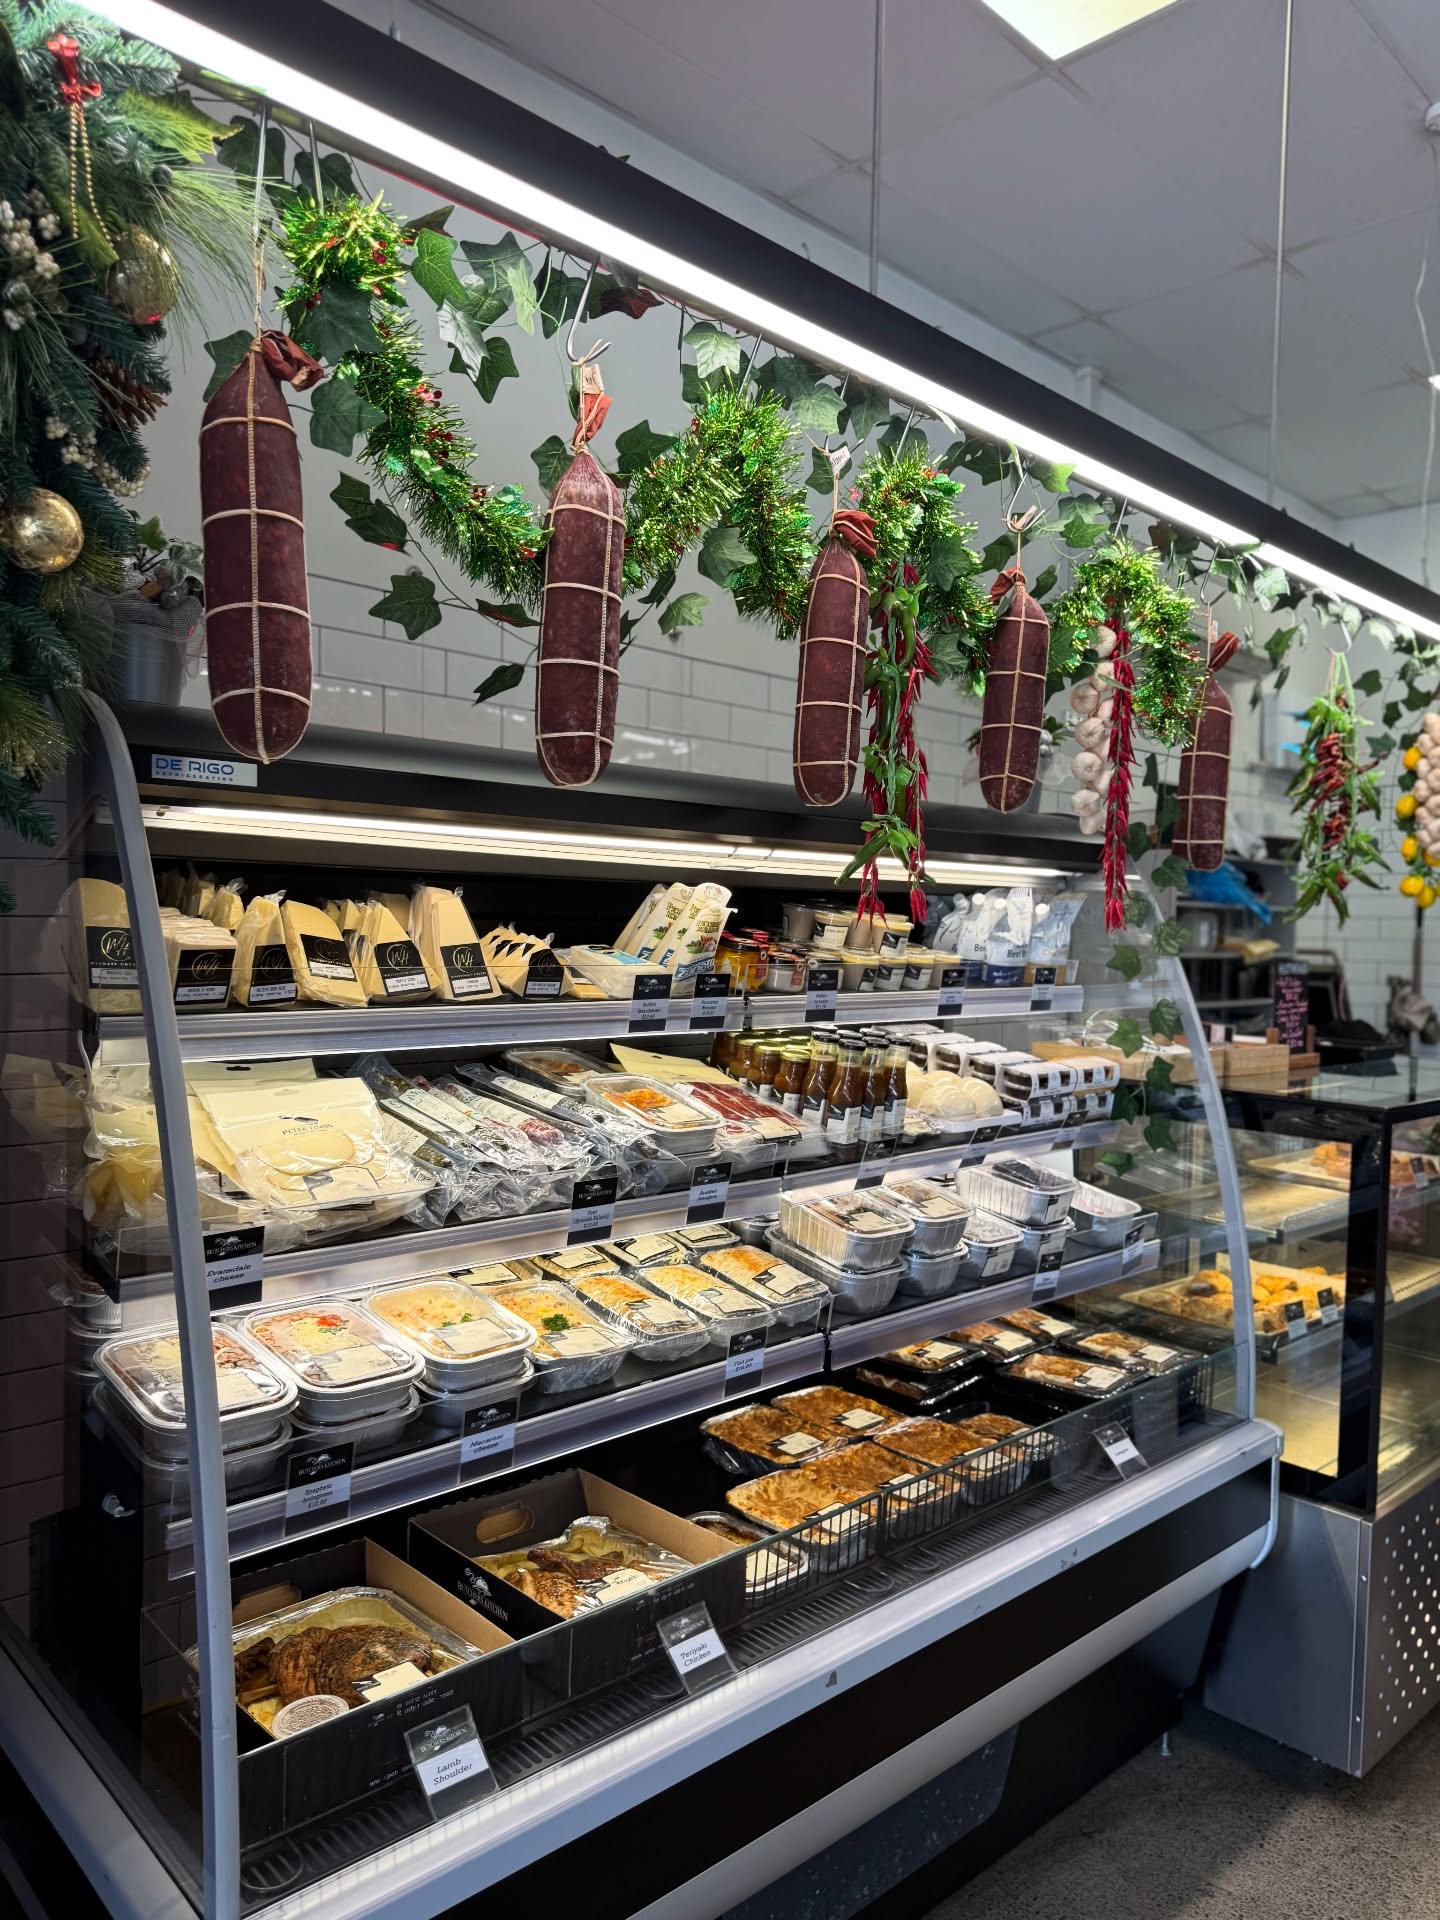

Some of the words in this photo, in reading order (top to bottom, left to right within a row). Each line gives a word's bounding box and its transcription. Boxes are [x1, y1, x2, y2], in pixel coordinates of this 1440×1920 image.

[155, 757, 182, 770] DE
[188, 761, 234, 776] RIGO
[213, 1273, 245, 1283] cheese
[469, 1433, 504, 1448] Macaroni
[473, 1442, 499, 1454] cheese
[302, 1490, 334, 1503] bolognese
[304, 1483, 333, 1496] Spaghetti
[457, 1580, 484, 1605] BUTCHERS
[484, 1600, 509, 1621] KITCHEN
[680, 1642, 708, 1660] Teriyaki
[683, 1649, 712, 1667] Chicken
[436, 1758, 462, 1774] Lamb
[432, 1763, 473, 1786] Shoulder
